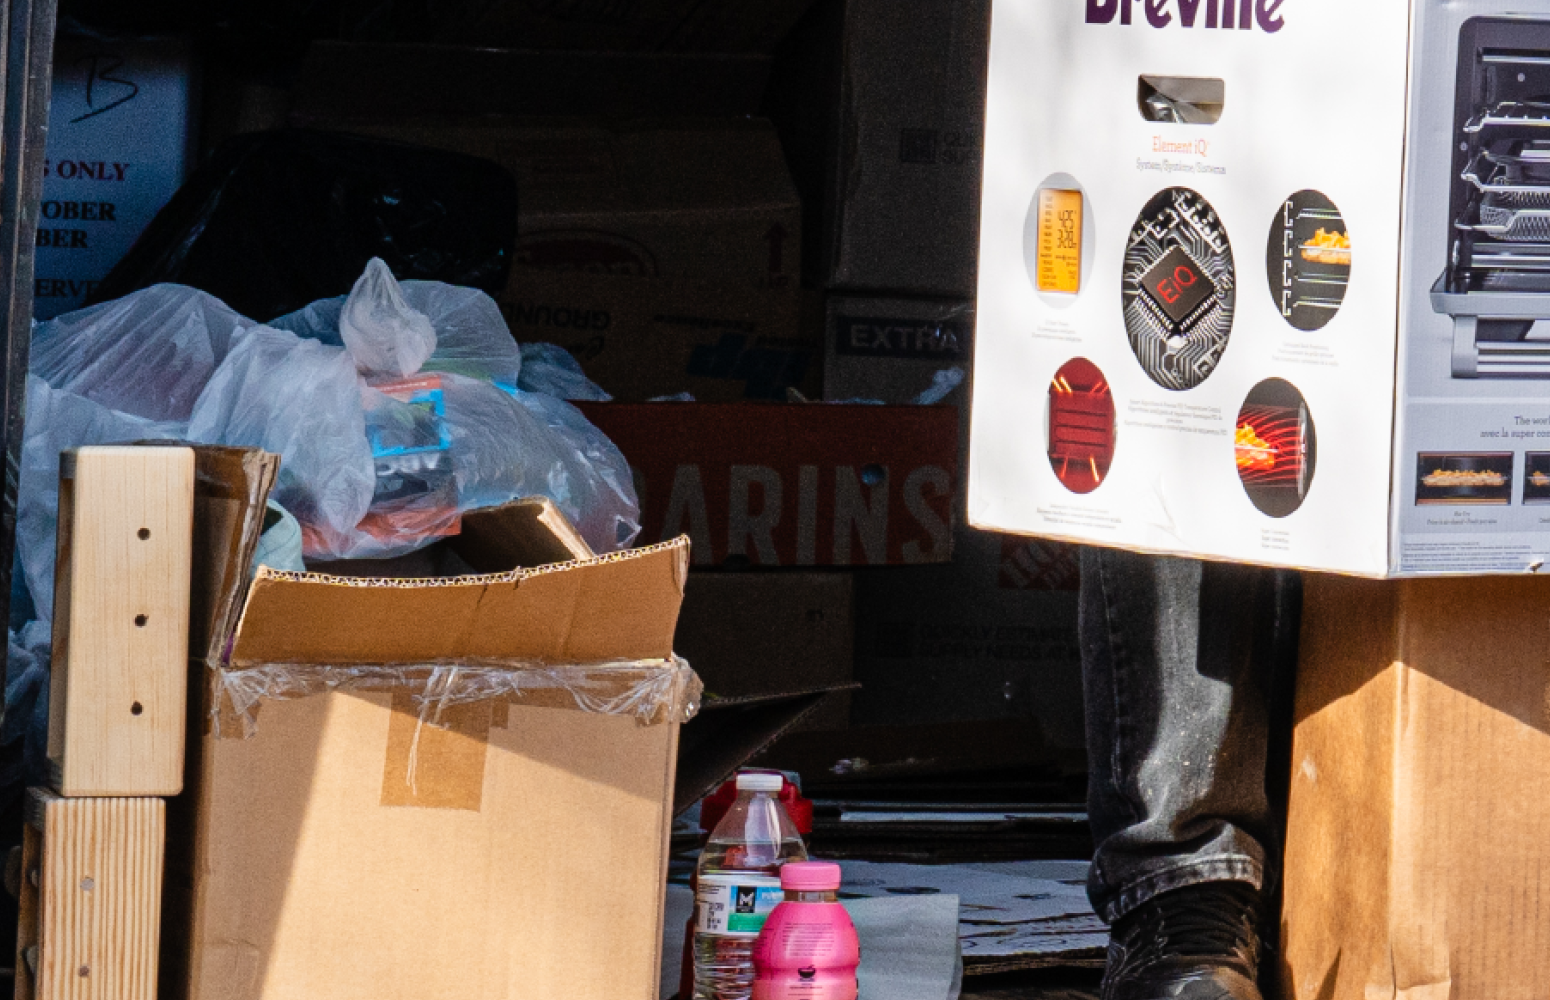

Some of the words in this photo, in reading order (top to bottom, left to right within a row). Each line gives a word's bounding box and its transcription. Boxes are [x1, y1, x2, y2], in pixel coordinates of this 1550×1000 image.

[57, 160, 130, 181] ONLY
[41, 201, 116, 221] OBER
[630, 464, 951, 566] ARINS
